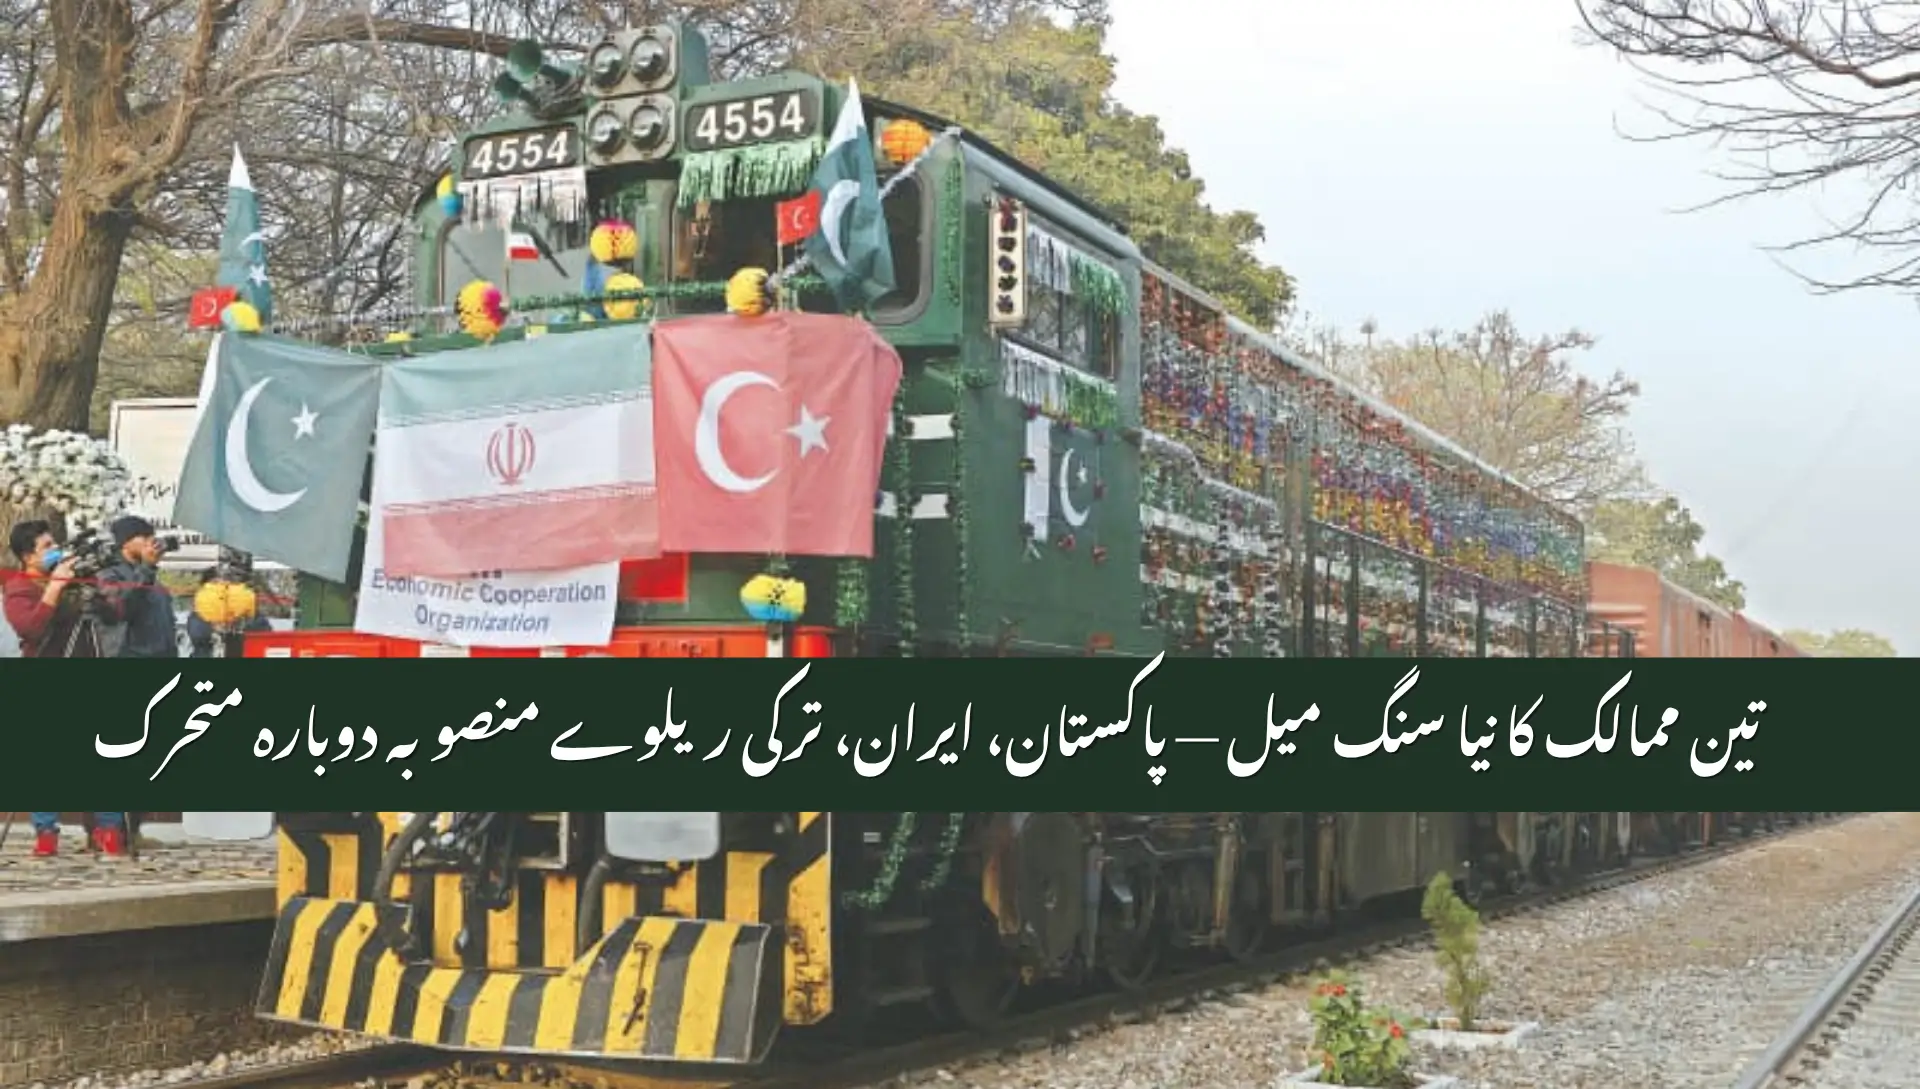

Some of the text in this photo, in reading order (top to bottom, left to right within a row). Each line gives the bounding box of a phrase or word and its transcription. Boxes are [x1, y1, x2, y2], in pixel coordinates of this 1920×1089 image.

[696, 95, 805, 144] 4554
[471, 130, 568, 173] 4554
[371, 568, 607, 609] Economic Cooperation
[414, 603, 551, 633] Organization
